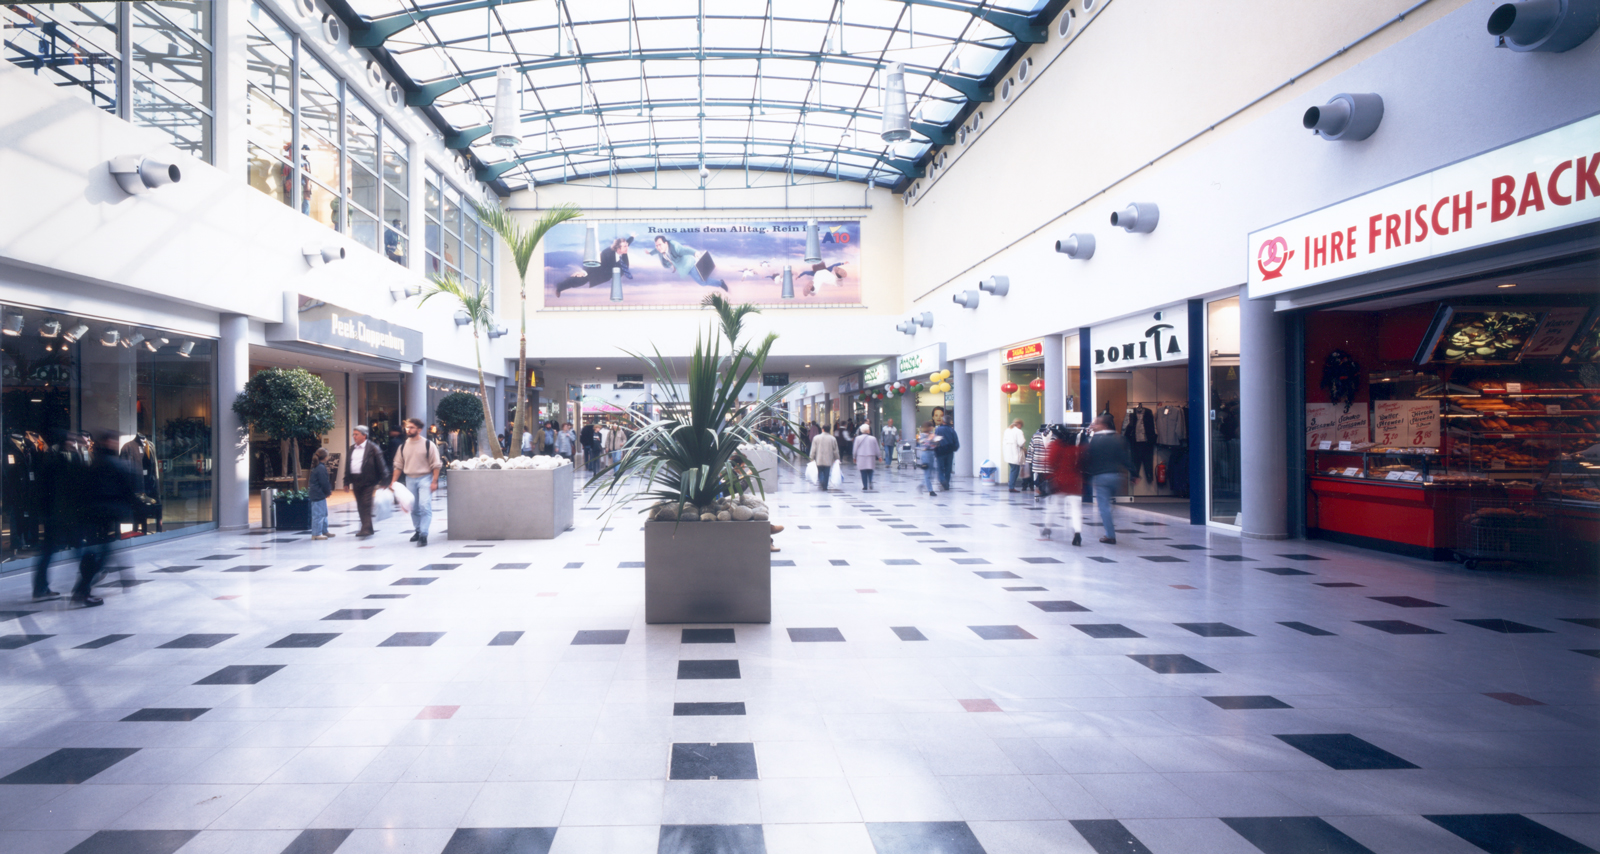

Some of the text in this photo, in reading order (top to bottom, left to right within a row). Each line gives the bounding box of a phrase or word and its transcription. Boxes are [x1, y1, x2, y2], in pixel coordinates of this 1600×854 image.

[648, 226, 677, 234] Raus
[703, 225, 726, 233] dem
[730, 225, 769, 235] Alltag.
[773, 225, 799, 233] Rein
[1304, 224, 1357, 271] IHRE
[331, 312, 355, 339] Peek
[358, 320, 405, 356] Cloppenburg
[1094, 322, 1182, 365] BONITA
